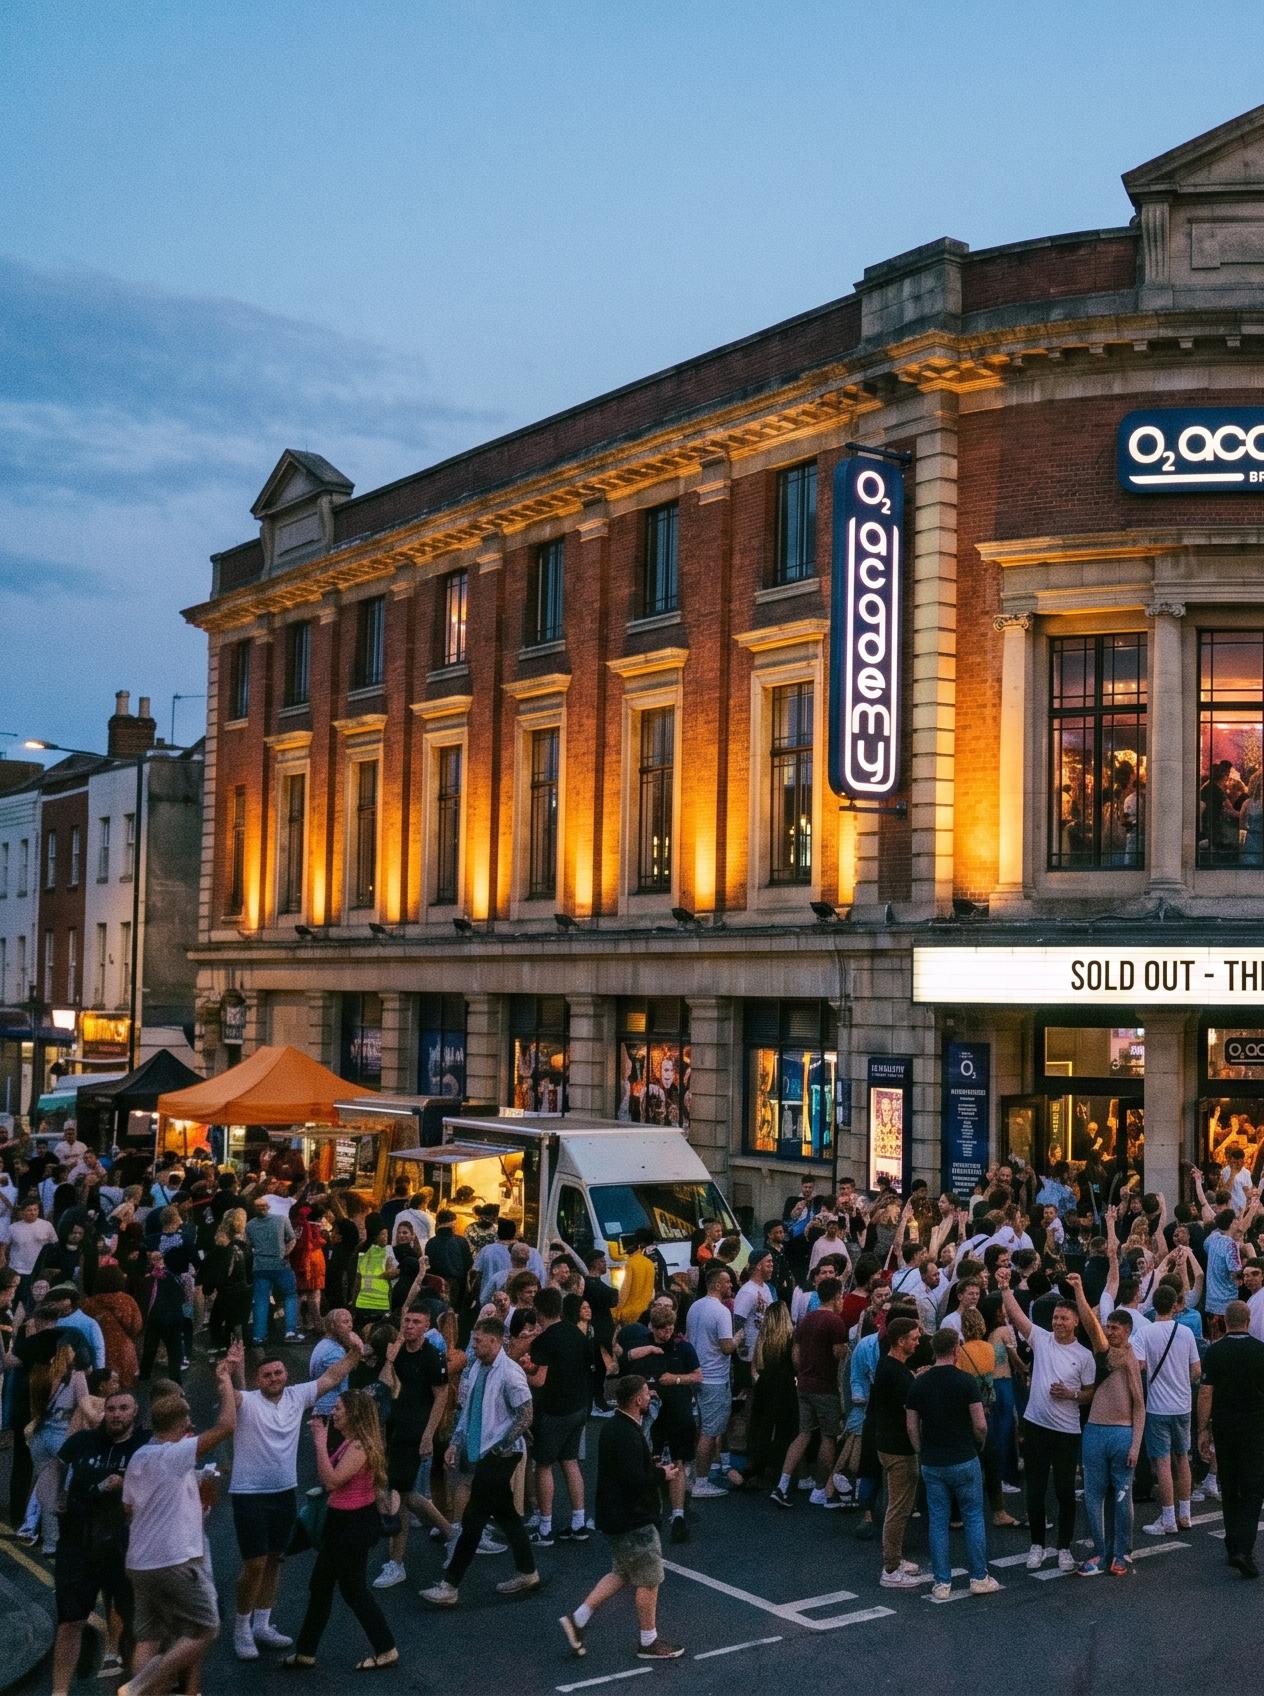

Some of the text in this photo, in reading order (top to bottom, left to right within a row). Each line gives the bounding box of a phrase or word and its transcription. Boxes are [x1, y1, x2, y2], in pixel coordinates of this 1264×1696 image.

[852, 521, 890, 783] academy
[1071, 960, 1135, 991] SOLD
[1145, 960, 1196, 991] OUT
